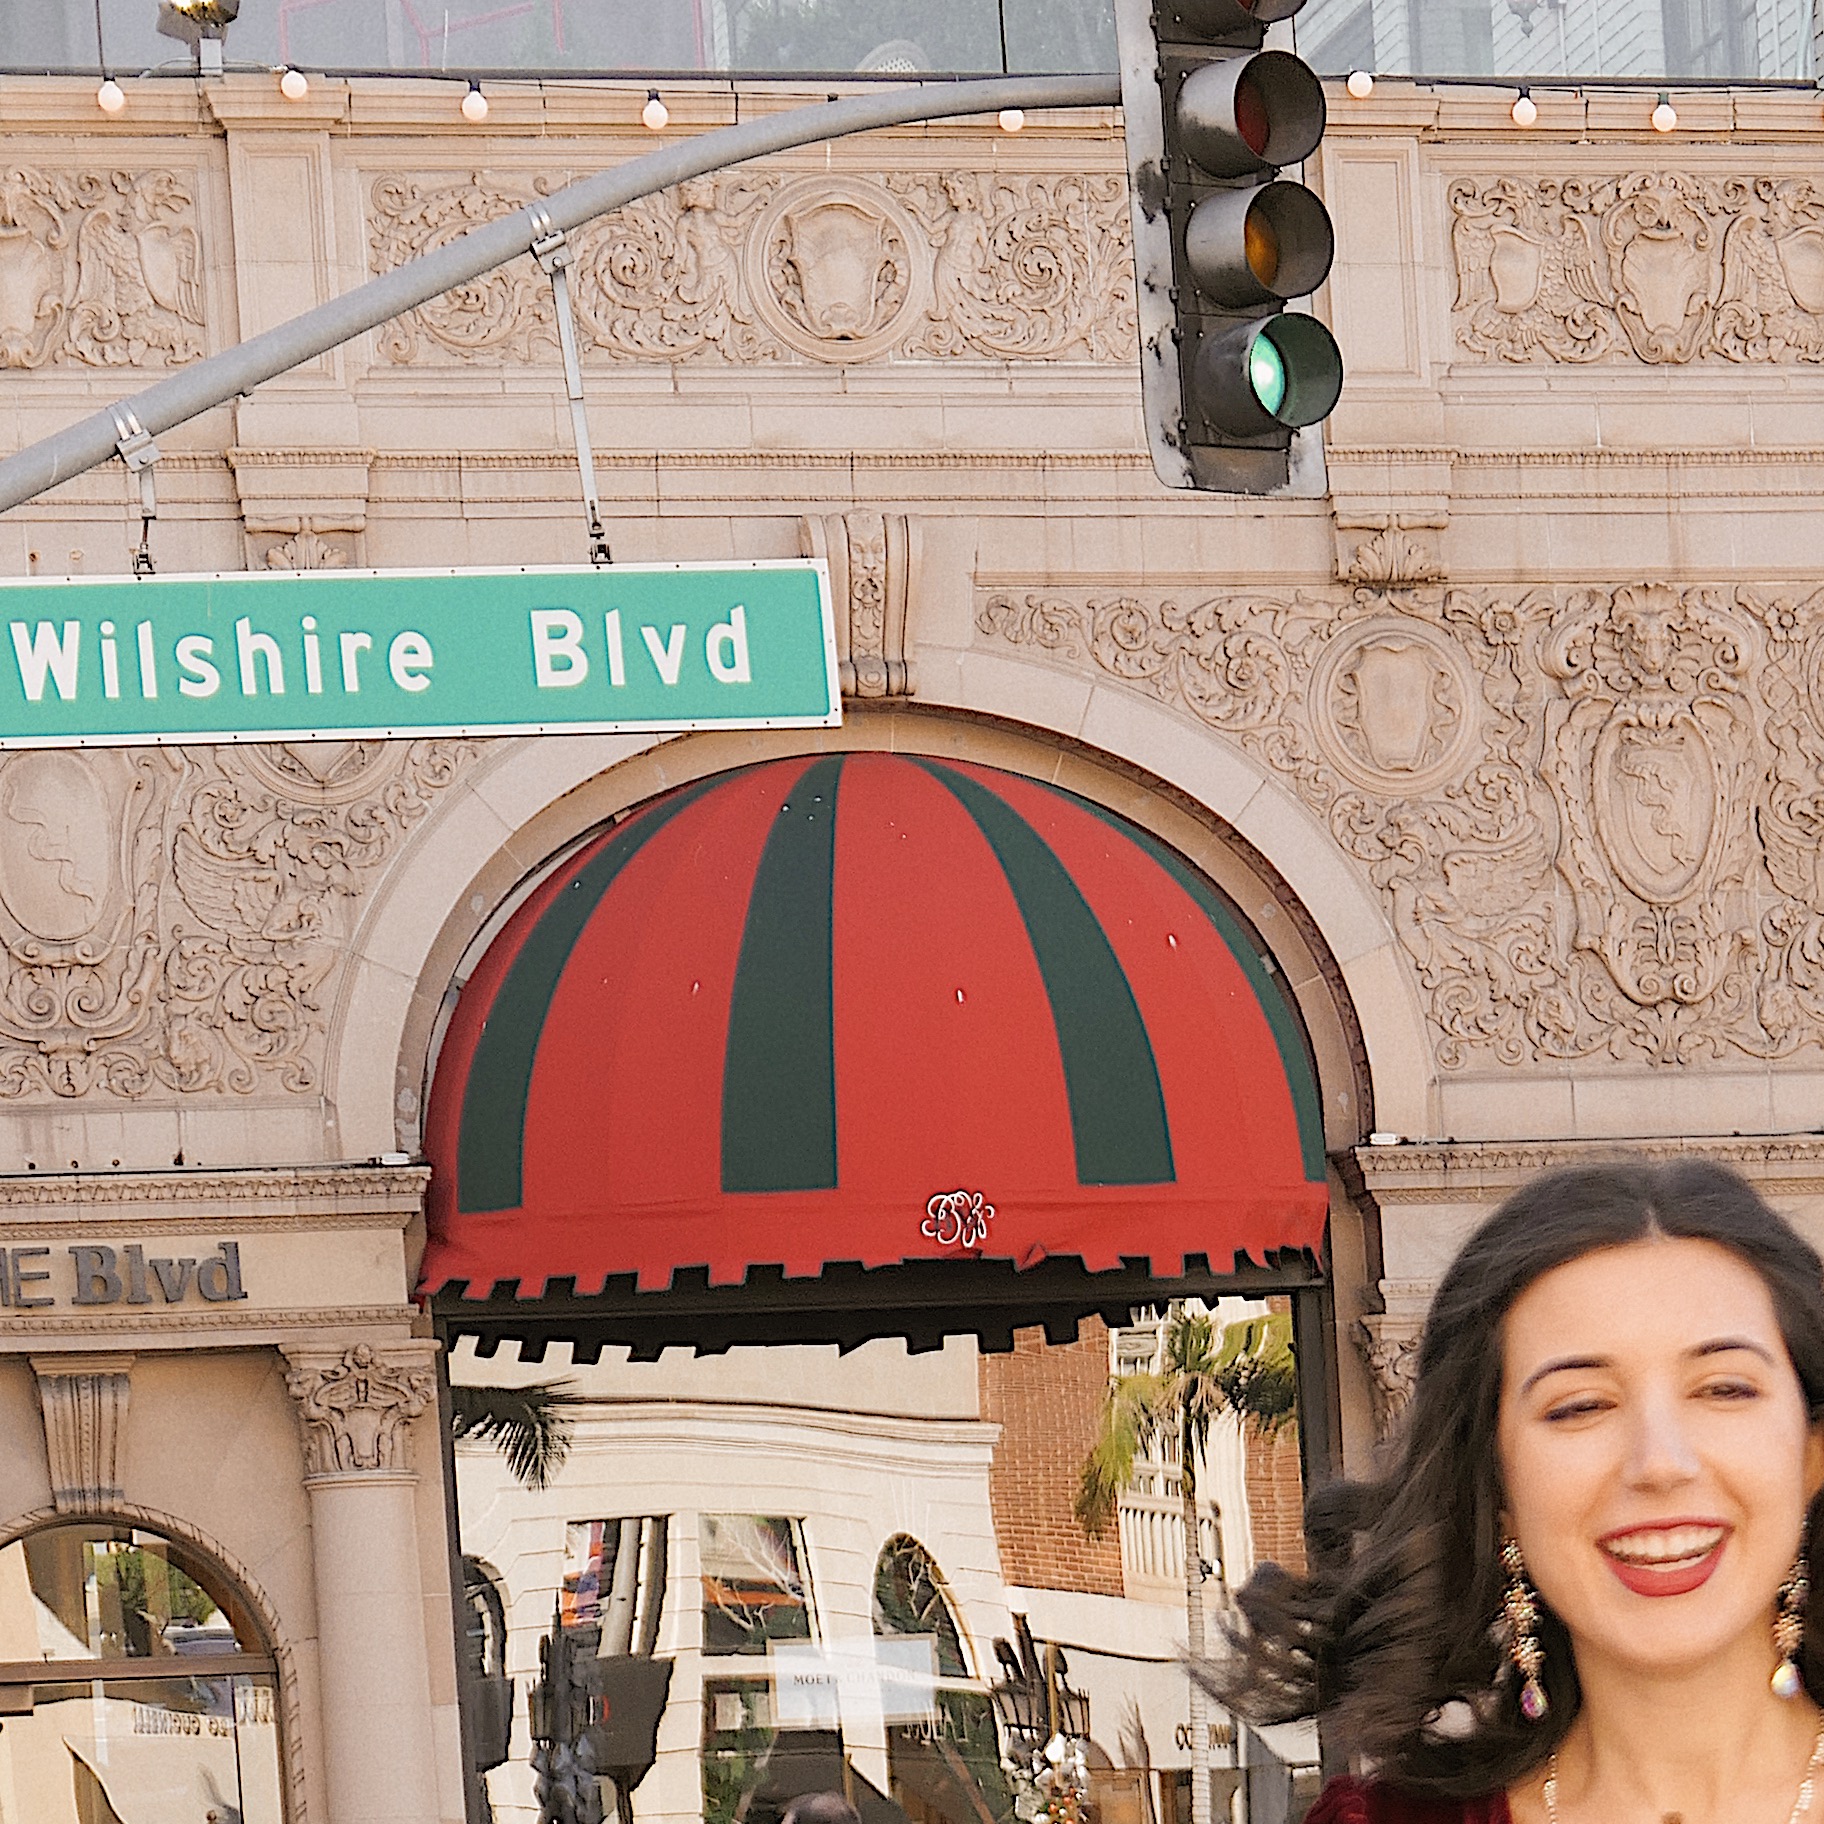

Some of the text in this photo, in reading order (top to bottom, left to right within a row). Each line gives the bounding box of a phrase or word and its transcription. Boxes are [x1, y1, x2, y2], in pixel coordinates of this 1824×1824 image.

[10, 605, 753, 701] Wilshire Blvd
[0, 1241, 248, 1308] E Blvd
